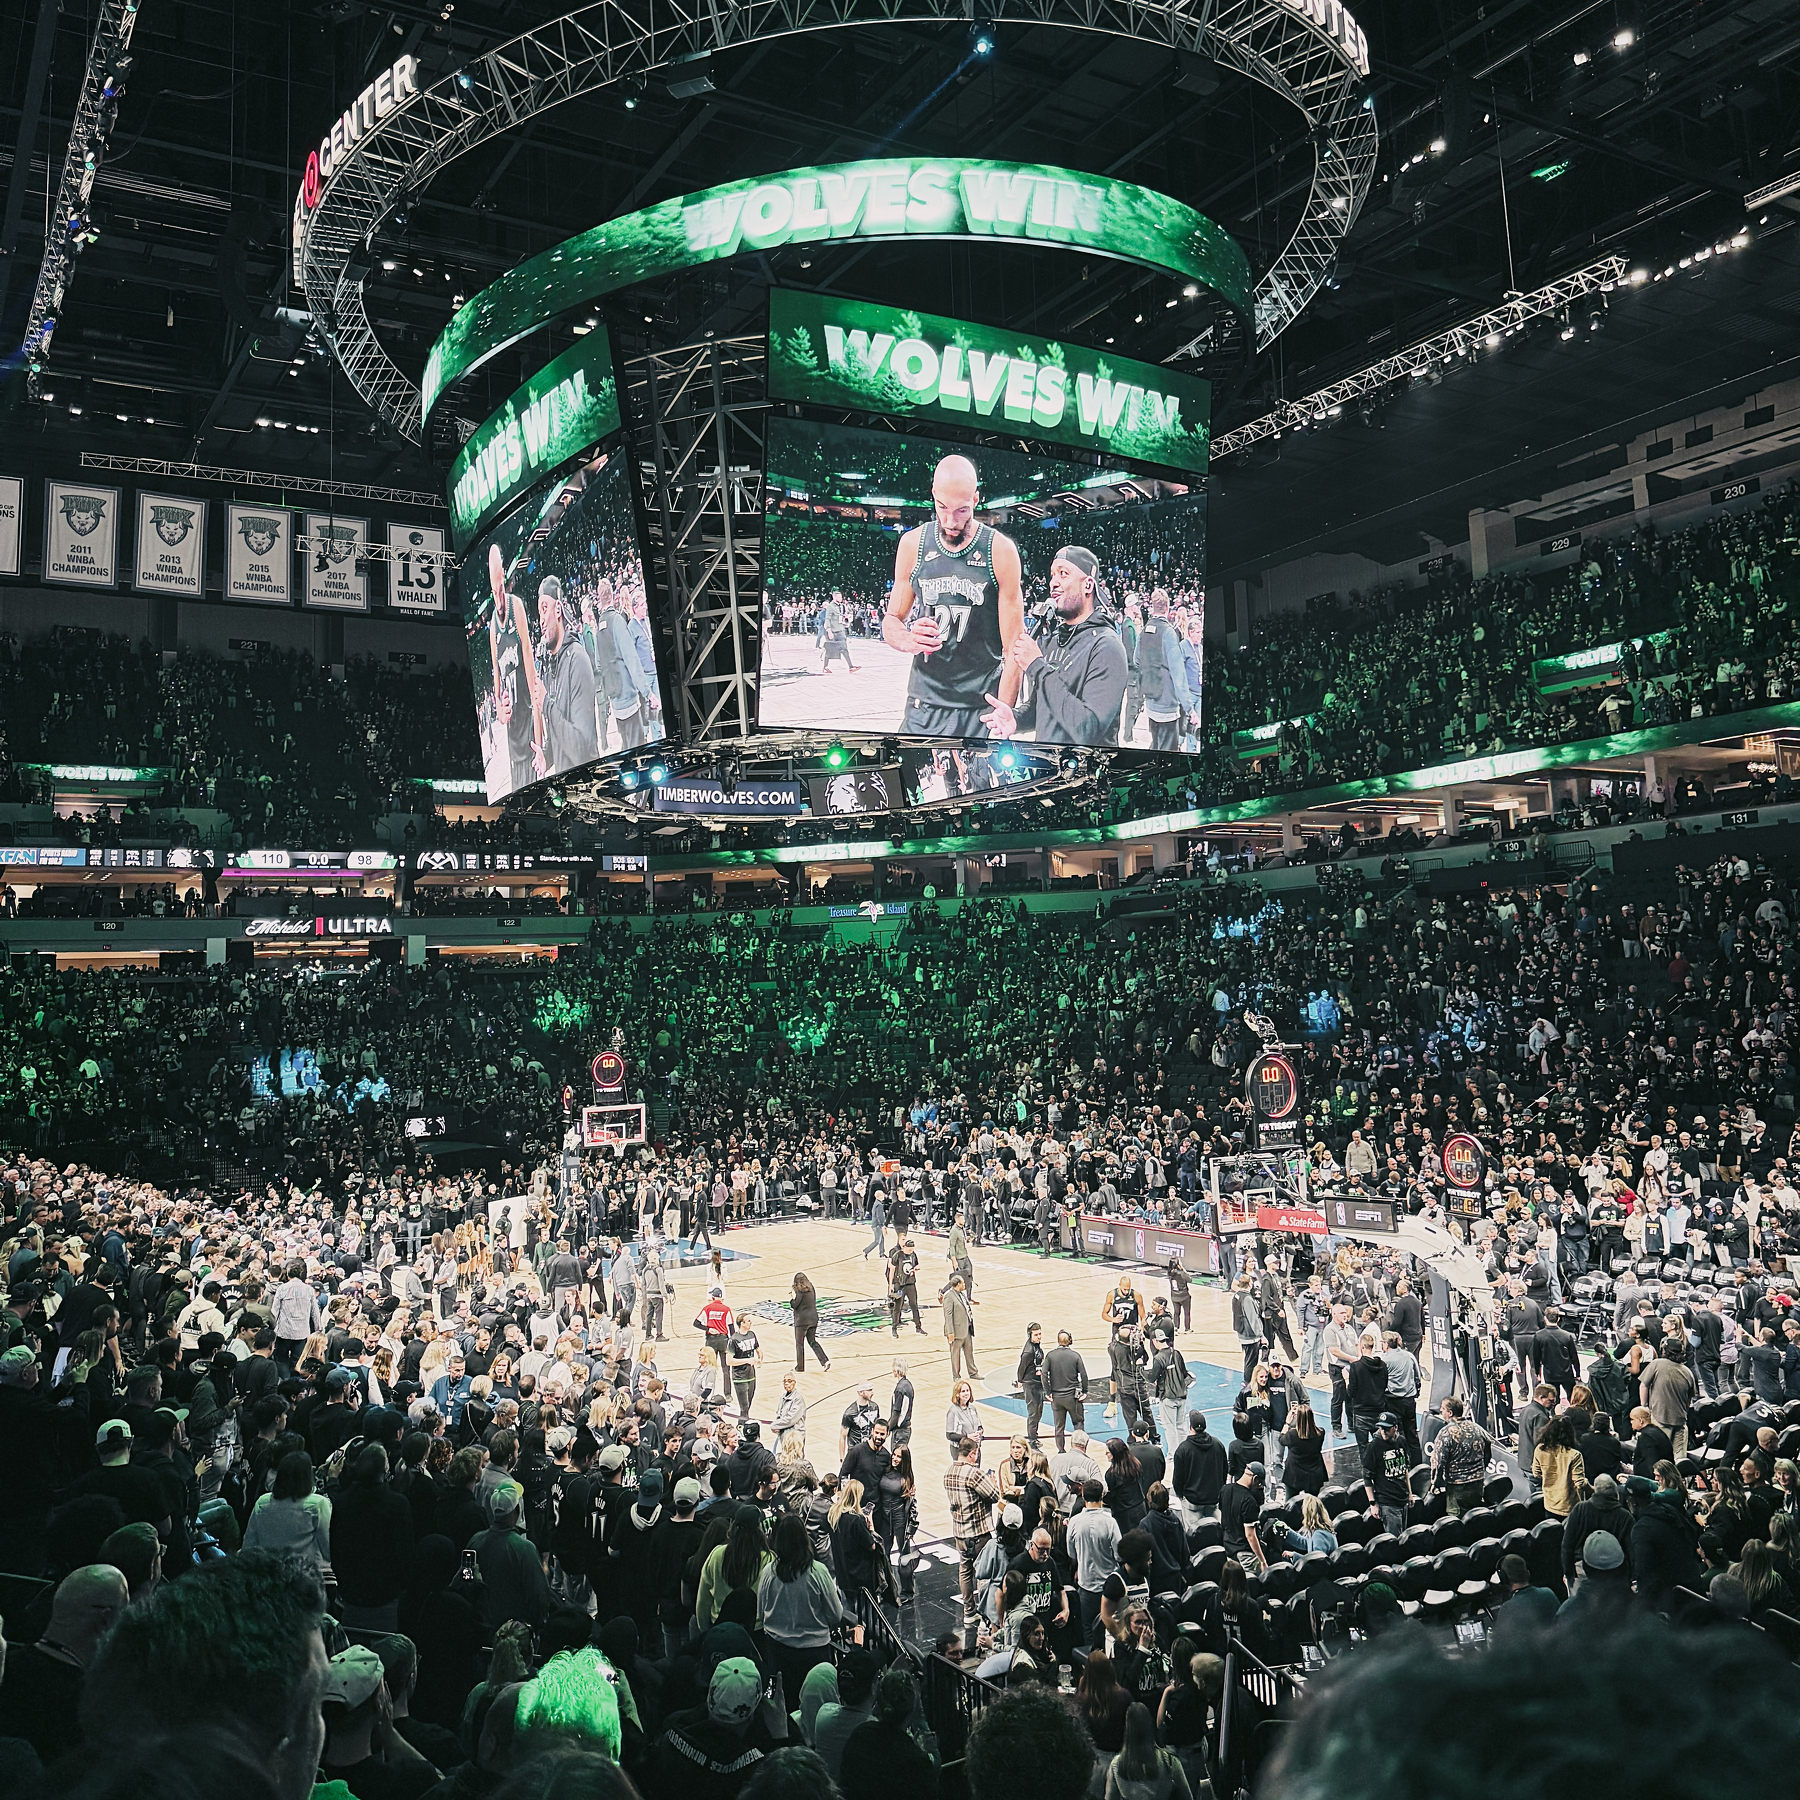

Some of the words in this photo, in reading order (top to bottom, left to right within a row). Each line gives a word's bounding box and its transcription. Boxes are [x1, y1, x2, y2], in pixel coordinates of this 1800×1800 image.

[319, 54, 420, 177] CENTER
[684, 167, 957, 260] WOLVES
[958, 170, 1103, 241] WIN
[824, 324, 1068, 428] WOLVES
[1075, 373, 1180, 440] WIN
[453, 420, 523, 520] WOLVES
[520, 368, 586, 469] WIN
[1724, 484, 1747, 500] 230
[70, 544, 92, 555] 2011
[1552, 537, 1571, 552] 229
[66, 554, 96, 565] WNBA
[159, 554, 181, 565] 2013
[966, 559, 987, 568] sezzle
[52, 562, 109, 578] CHAMPIONS
[156, 563, 183, 575] WNBA
[248, 563, 270, 573] 2015
[397, 554, 436, 589] 13
[142, 571, 197, 586] CHAMPIONS
[246, 572, 272, 584] WNBA
[326, 571, 347, 581] 2017
[232, 581, 285, 595] CHAMPIONS
[324, 580, 350, 591] WNBA
[918, 575, 988, 606] TIMBERWOLVES
[311, 588, 362, 601] CHAMPIONS
[397, 590, 438, 604] WHALEN
[400, 608, 413, 616] HALL
[934, 604, 972, 643] 27
[240, 640, 258, 651] 221
[1565, 646, 1620, 671] WOLVES
[51, 766, 108, 782] WOLVES
[1414, 757, 1492, 789] WOLVES
[1494, 749, 1541, 777] WIN
[432, 780, 478, 793] WOLVES
[657, 786, 795, 806] TIMBERWOLVES.COM
[1730, 813, 1748, 824] 131
[1504, 842, 1519, 852] 130
[262, 853, 283, 865] 110
[308, 853, 329, 866] 0.0
[358, 855, 372, 865] 98
[612, 856, 625, 864] BOS
[613, 863, 625, 871] PHI
[828, 905, 857, 918] Treasure
[886, 902, 908, 914] Island
[102, 922, 116, 930] 120
[245, 920, 314, 936] Michelob
[328, 918, 392, 933] ULTRA
[1262, 1066, 1280, 1083] 0.0
[1270, 1120, 1298, 1131] TISSOT
[1455, 1148, 1472, 1163] 0.0
[1355, 1209, 1382, 1222] ESPN
[1087, 1229, 1115, 1246] ESPN
[1155, 1240, 1185, 1258] ESPN
[1433, 1315, 1445, 1331] GET
[1434, 1330, 1448, 1345] THE
[1755, 1406, 1771, 1419] 3
[1222, 1612, 1238, 1623] REID
